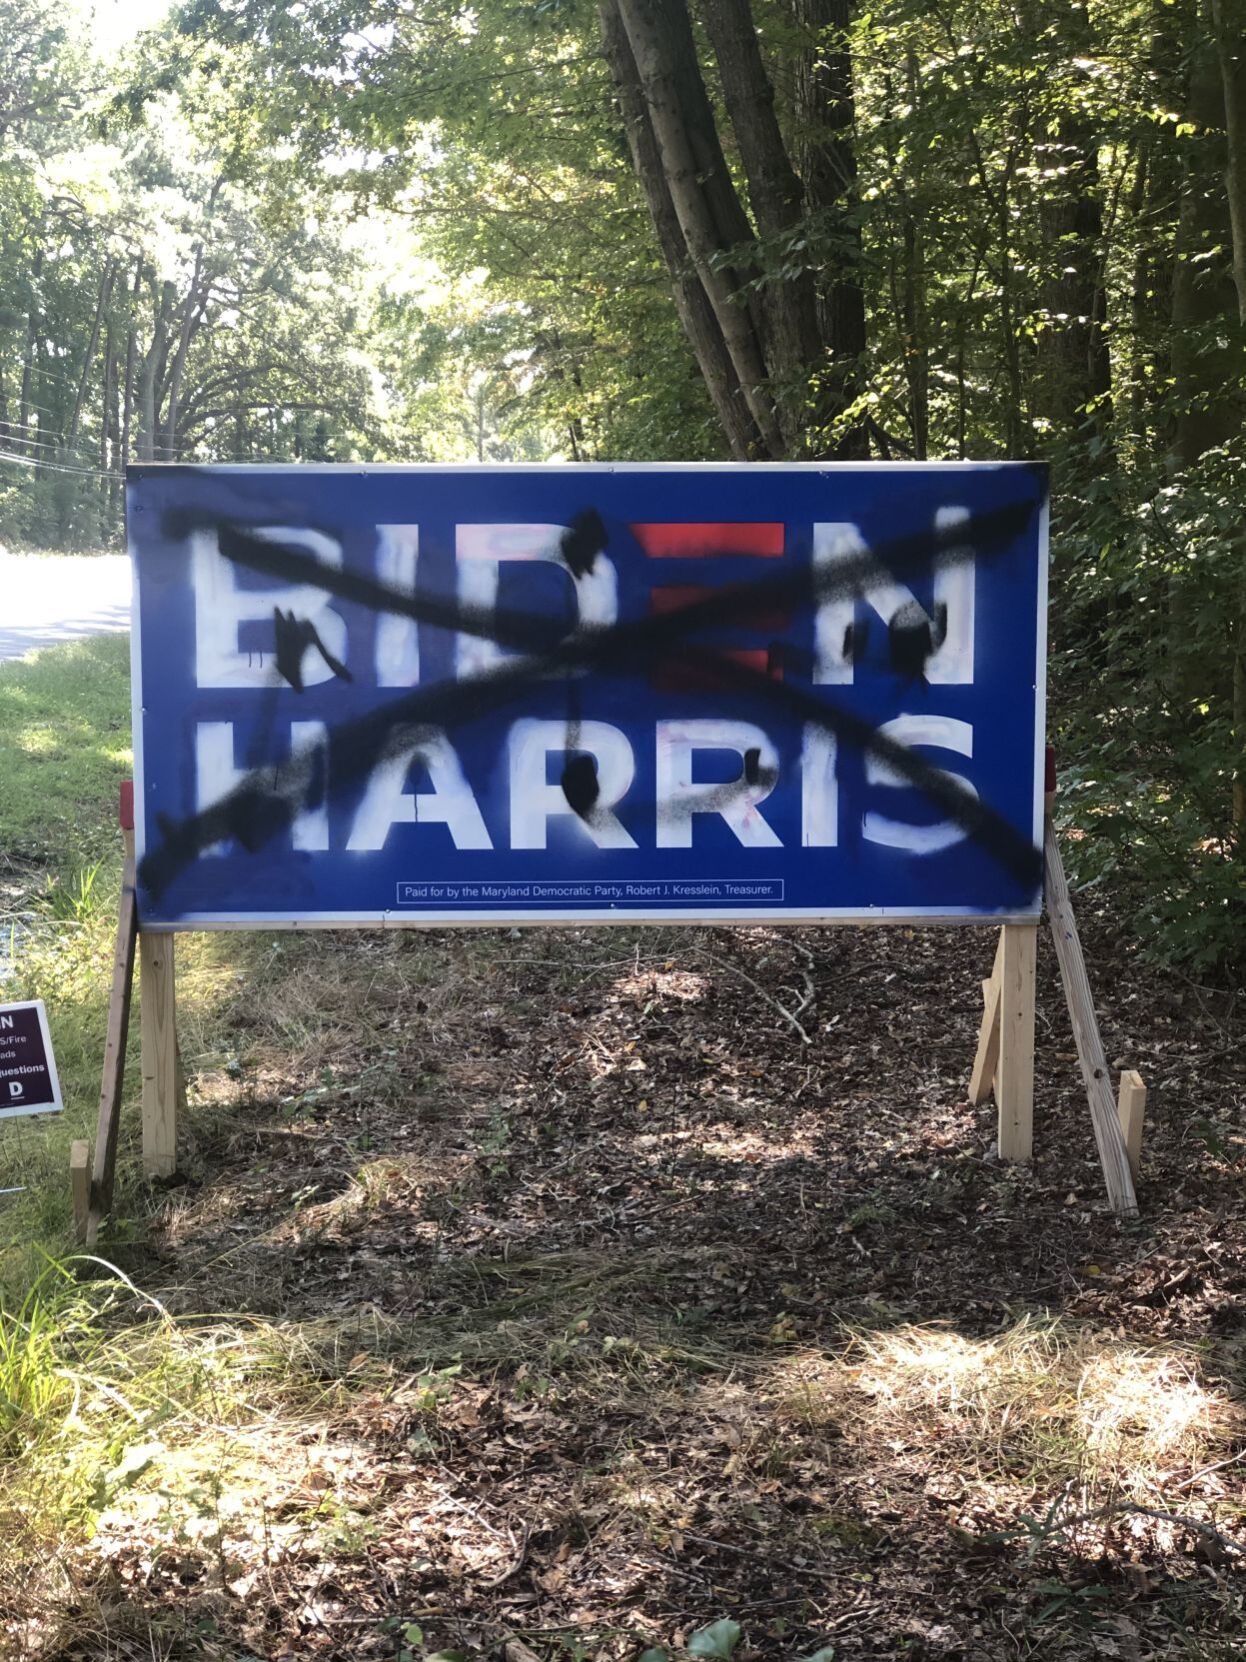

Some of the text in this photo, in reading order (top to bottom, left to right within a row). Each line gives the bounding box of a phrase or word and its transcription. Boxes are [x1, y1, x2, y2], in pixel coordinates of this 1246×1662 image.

[190, 512, 977, 688] BIDEN
[194, 714, 981, 854] HARRIS
[405, 883, 774, 899] Paid for by the Maryland Democratic Party, Robert J. Kresslein, Treasurer.
[9, 1081, 23, 1097] D
